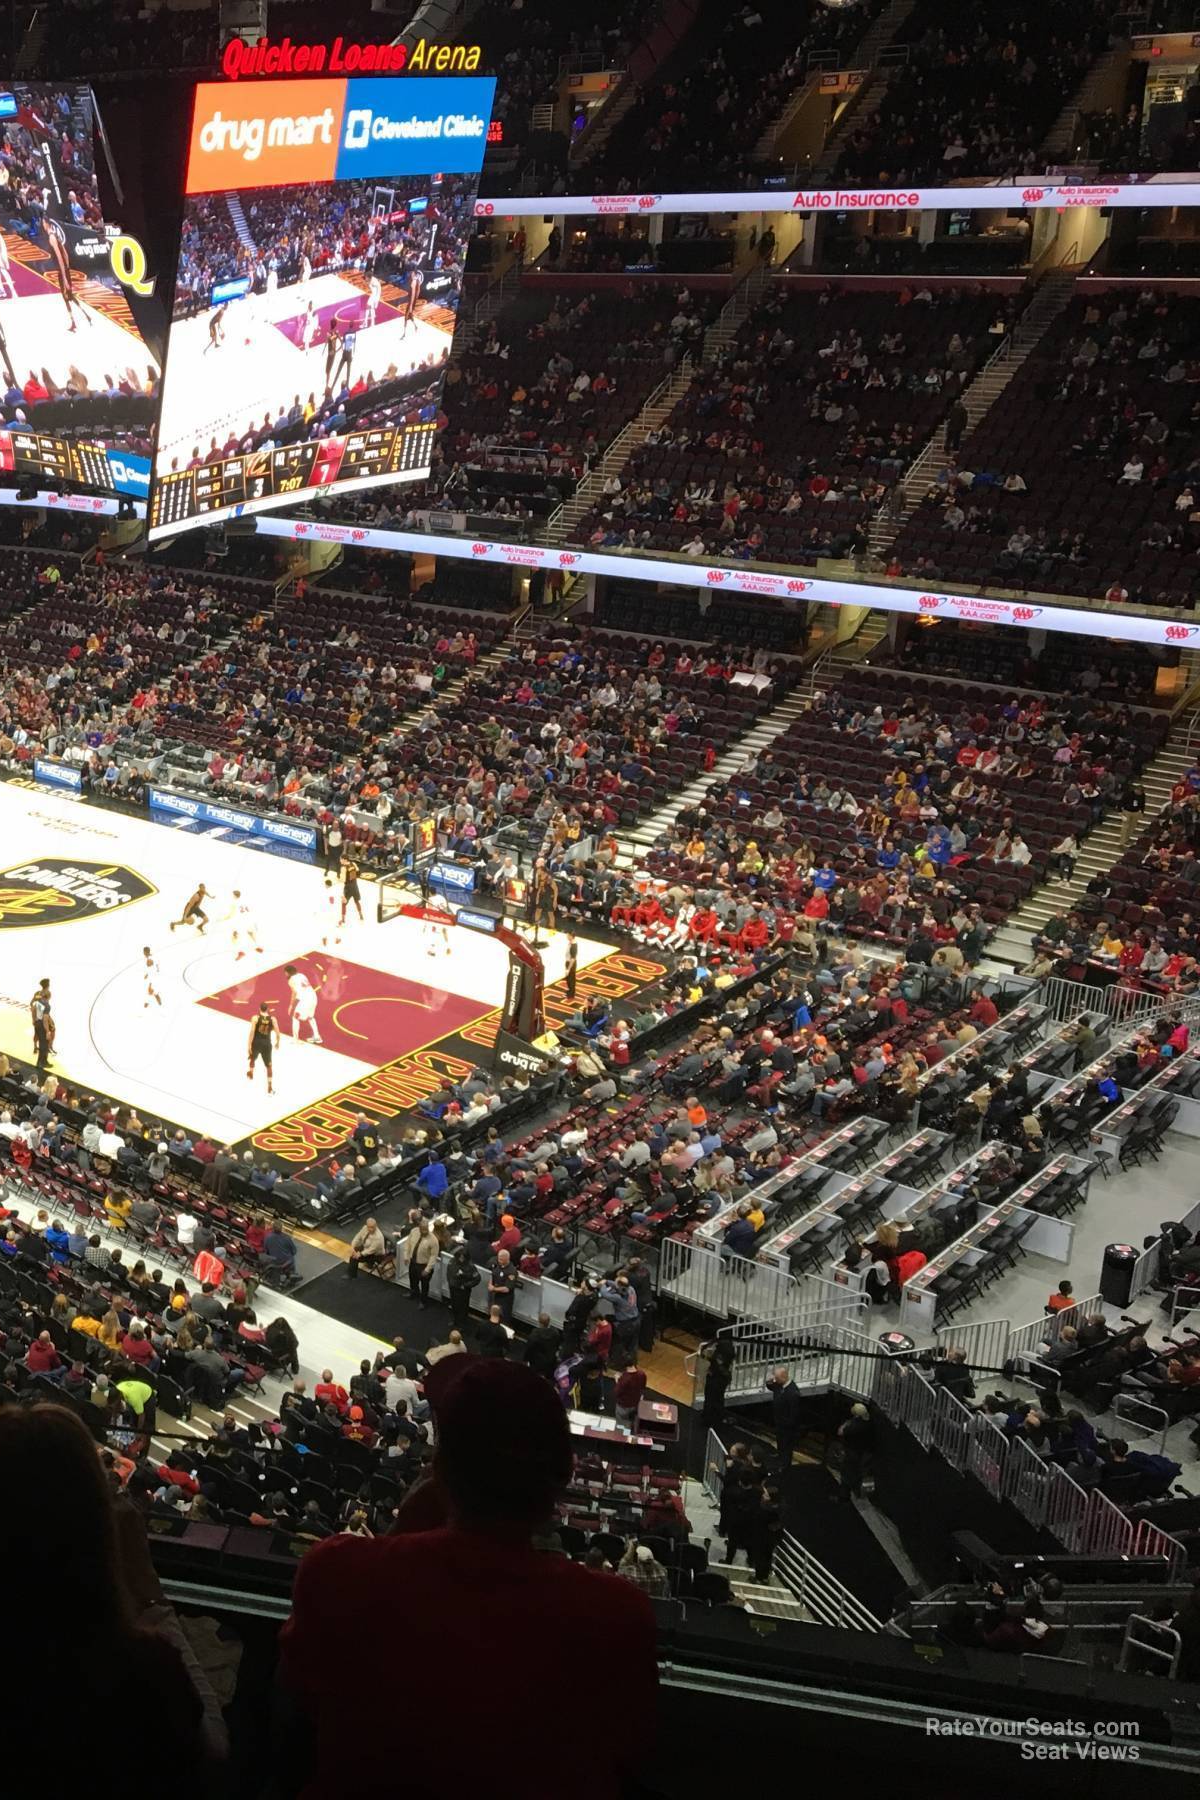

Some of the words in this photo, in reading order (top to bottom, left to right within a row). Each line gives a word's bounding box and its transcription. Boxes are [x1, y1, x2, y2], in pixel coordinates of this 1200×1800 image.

[223, 38, 326, 79] Quicken
[328, 37, 408, 71] Loans
[409, 38, 481, 71] Arena
[200, 111, 266, 160] drug
[267, 108, 334, 147] mart
[371, 116, 442, 141] Cleveland
[443, 115, 484, 137] Clinic
[793, 192, 831, 208] Auto
[835, 191, 919, 207] Insurance
[1078, 186, 1119, 194] Insurance
[1066, 198, 1107, 206] AAA.com
[107, 235, 156, 297] Q
[280, 476, 303, 492] 7:07
[321, 464, 330, 483] 7
[253, 478, 264, 498] 3
[742, 583, 775, 592] AAA.com
[751, 574, 784, 584] Insurance
[950, 598, 969, 606] Auto
[970, 600, 1010, 611] Insurance
[960, 609, 999, 620] AAA.com
[36, 761, 81, 787] FirstEnergy
[6, 777, 88, 802] CAVS.COM
[152, 792, 199, 816] FirstEnergy
[206, 805, 255, 831] FirstEnergy
[263, 819, 315, 844] FirstEnergy
[4, 865, 132, 909] CAVALIERS
